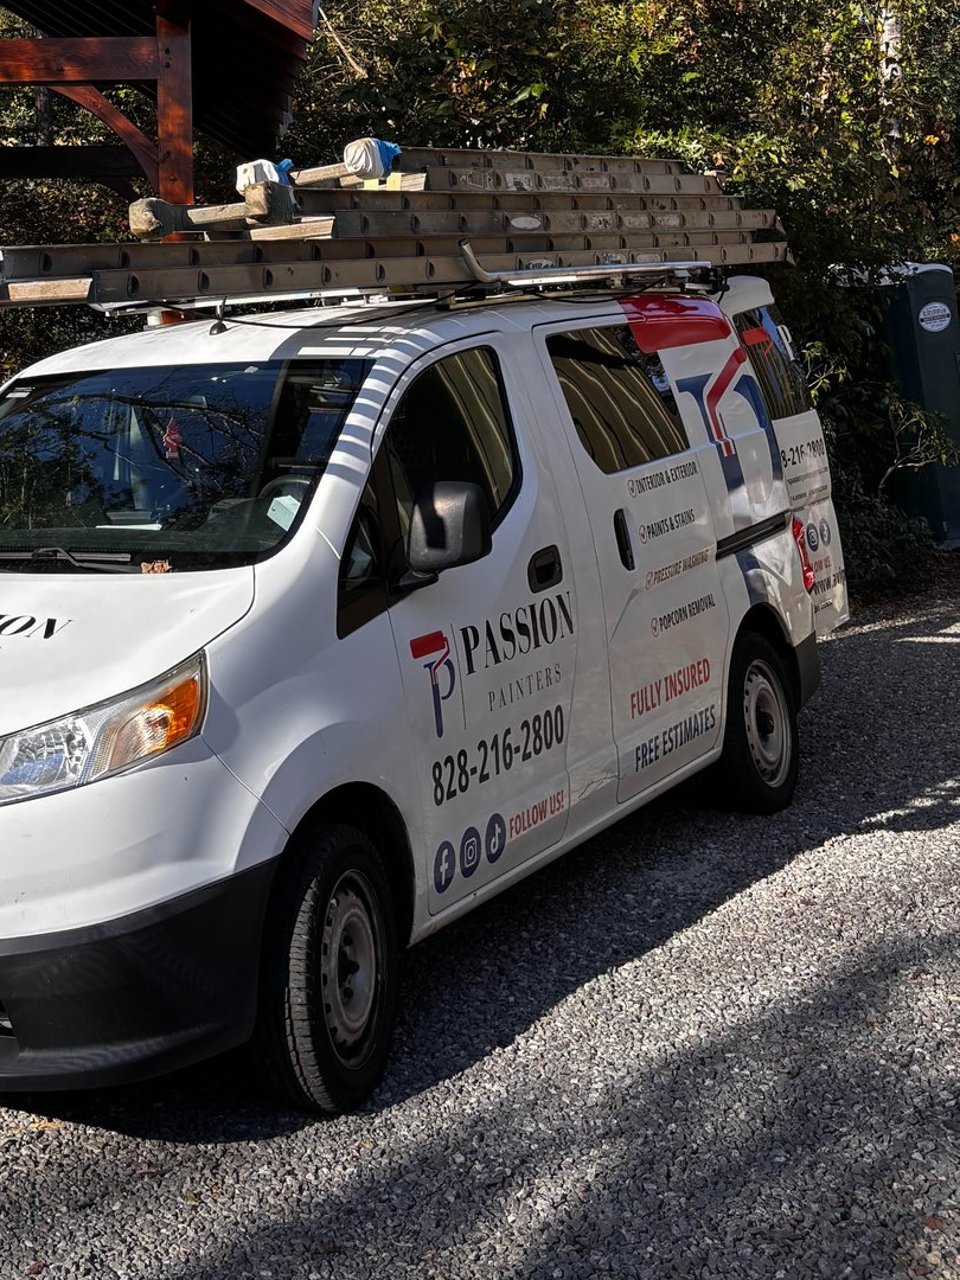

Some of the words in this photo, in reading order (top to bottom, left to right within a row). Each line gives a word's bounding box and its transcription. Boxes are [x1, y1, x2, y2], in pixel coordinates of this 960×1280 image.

[635, 471, 666, 494] INTERIOR
[665, 470, 672, 483] &
[670, 461, 699, 482] EXTERIOR
[647, 518, 669, 539] PAINTS
[669, 517, 675, 530] &
[674, 508, 695, 529] STAINS
[653, 561, 681, 585] PRESSURE
[682, 549, 709, 573] WASHING
[458, 591, 574, 676] PASSION
[659, 605, 689, 632] POPCORN
[688, 593, 716, 618] REMOVAL
[488, 663, 562, 712] PAINTERS
[630, 678, 662, 719] FULLY
[664, 658, 711, 702] INSURED
[432, 704, 564, 806] 828-216-2800
[635, 735, 659, 773] FREE
[662, 704, 716, 757] ESTIMATES
[509, 800, 548, 839] FOLLOW
[549, 789, 565, 815] US!
